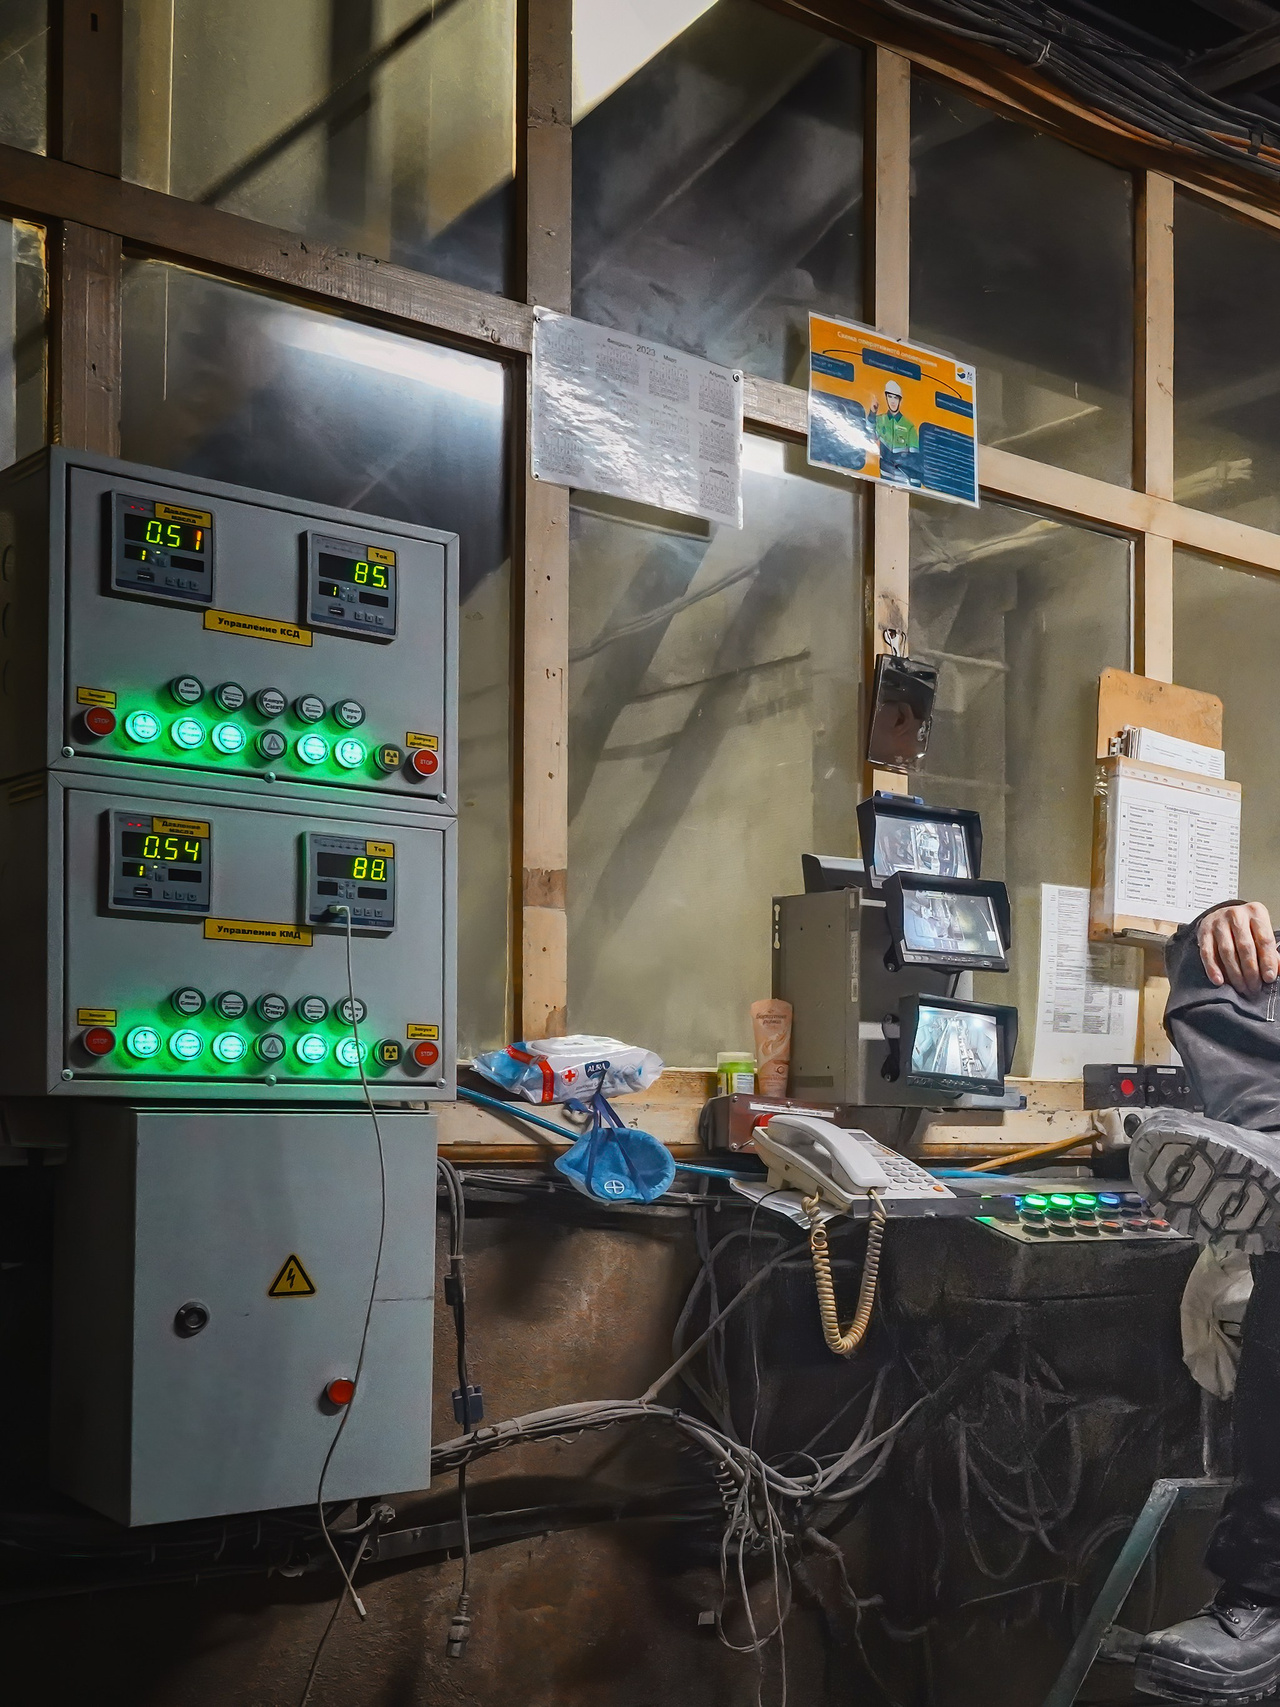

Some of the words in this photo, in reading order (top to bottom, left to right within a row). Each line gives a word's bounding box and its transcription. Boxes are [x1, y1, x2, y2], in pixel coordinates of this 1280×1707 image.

[636, 344, 656, 356] 2023
[217, 617, 278, 634] Управление
[280, 628, 301, 639] КСД
[143, 835, 199, 861] 0.54
[217, 925, 277, 937] Управление
[279, 930, 302, 940] КМД
